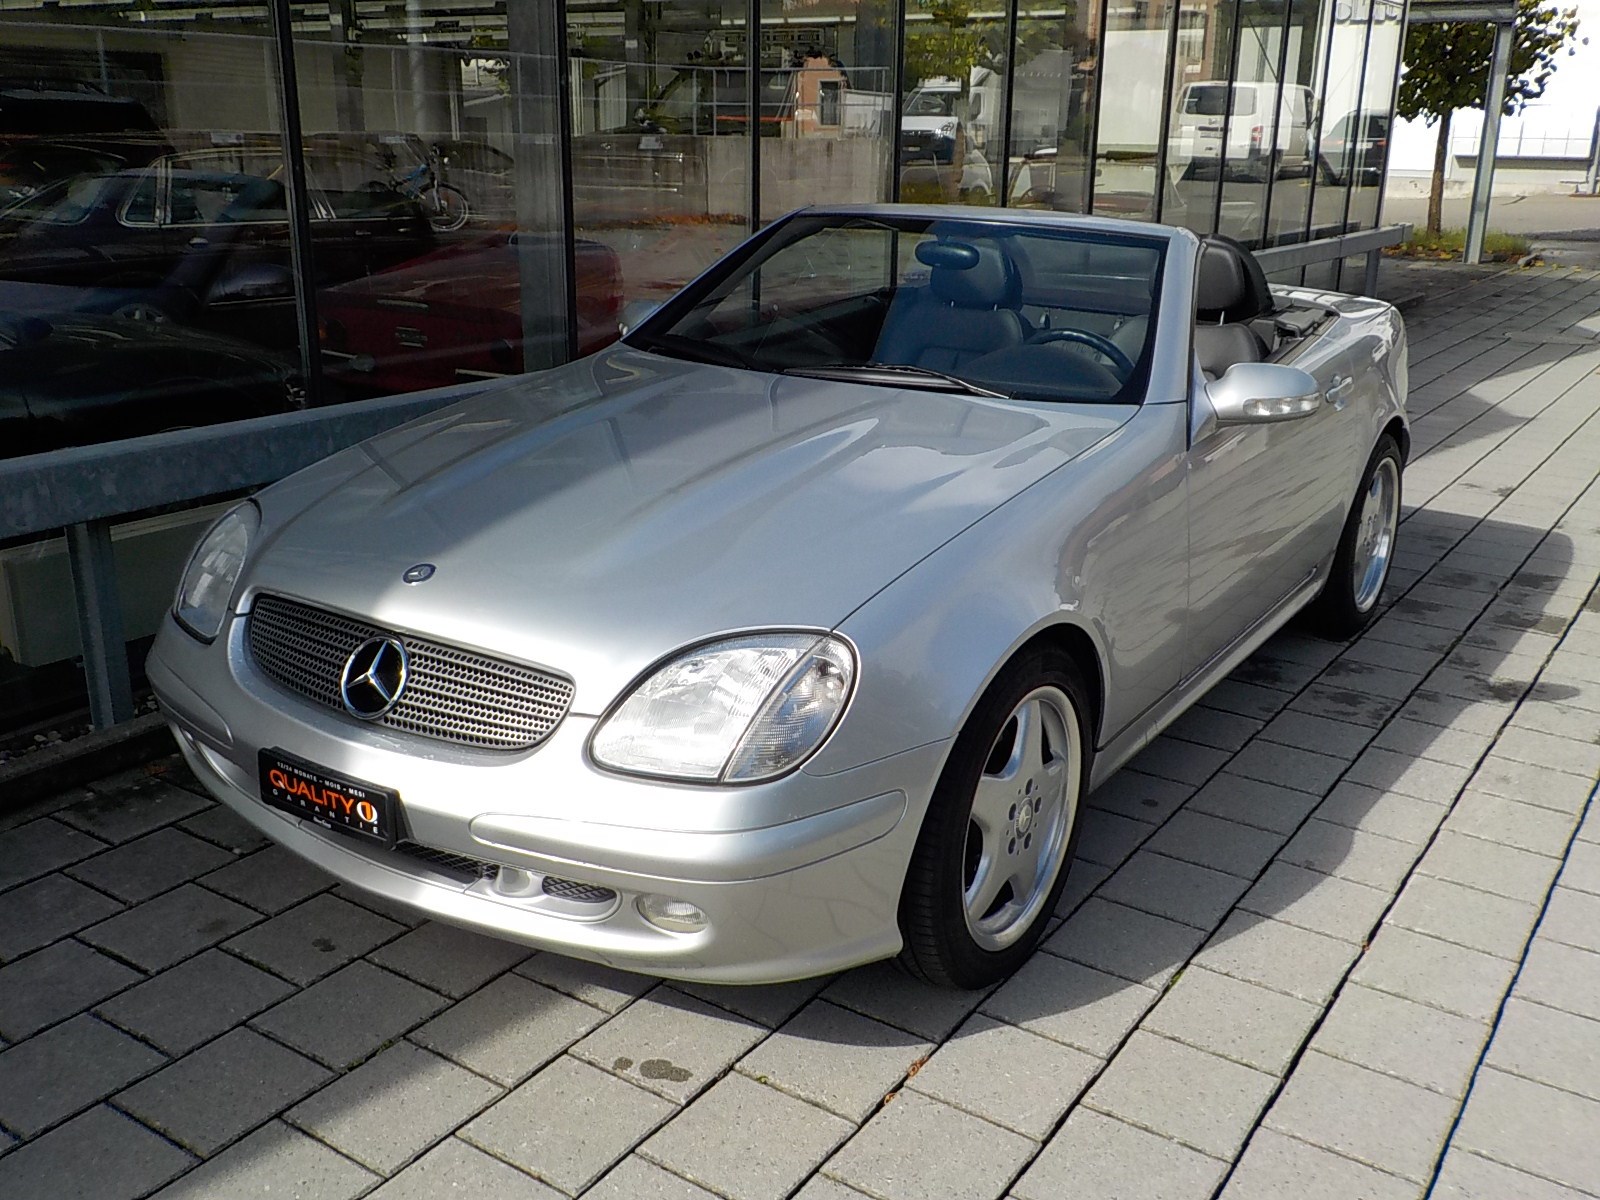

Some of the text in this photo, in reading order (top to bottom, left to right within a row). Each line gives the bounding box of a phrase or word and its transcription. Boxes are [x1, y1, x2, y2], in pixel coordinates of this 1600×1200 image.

[269, 769, 355, 814] QUALITY
[325, 780, 341, 791] MOIS
[349, 787, 365, 798] MESI
